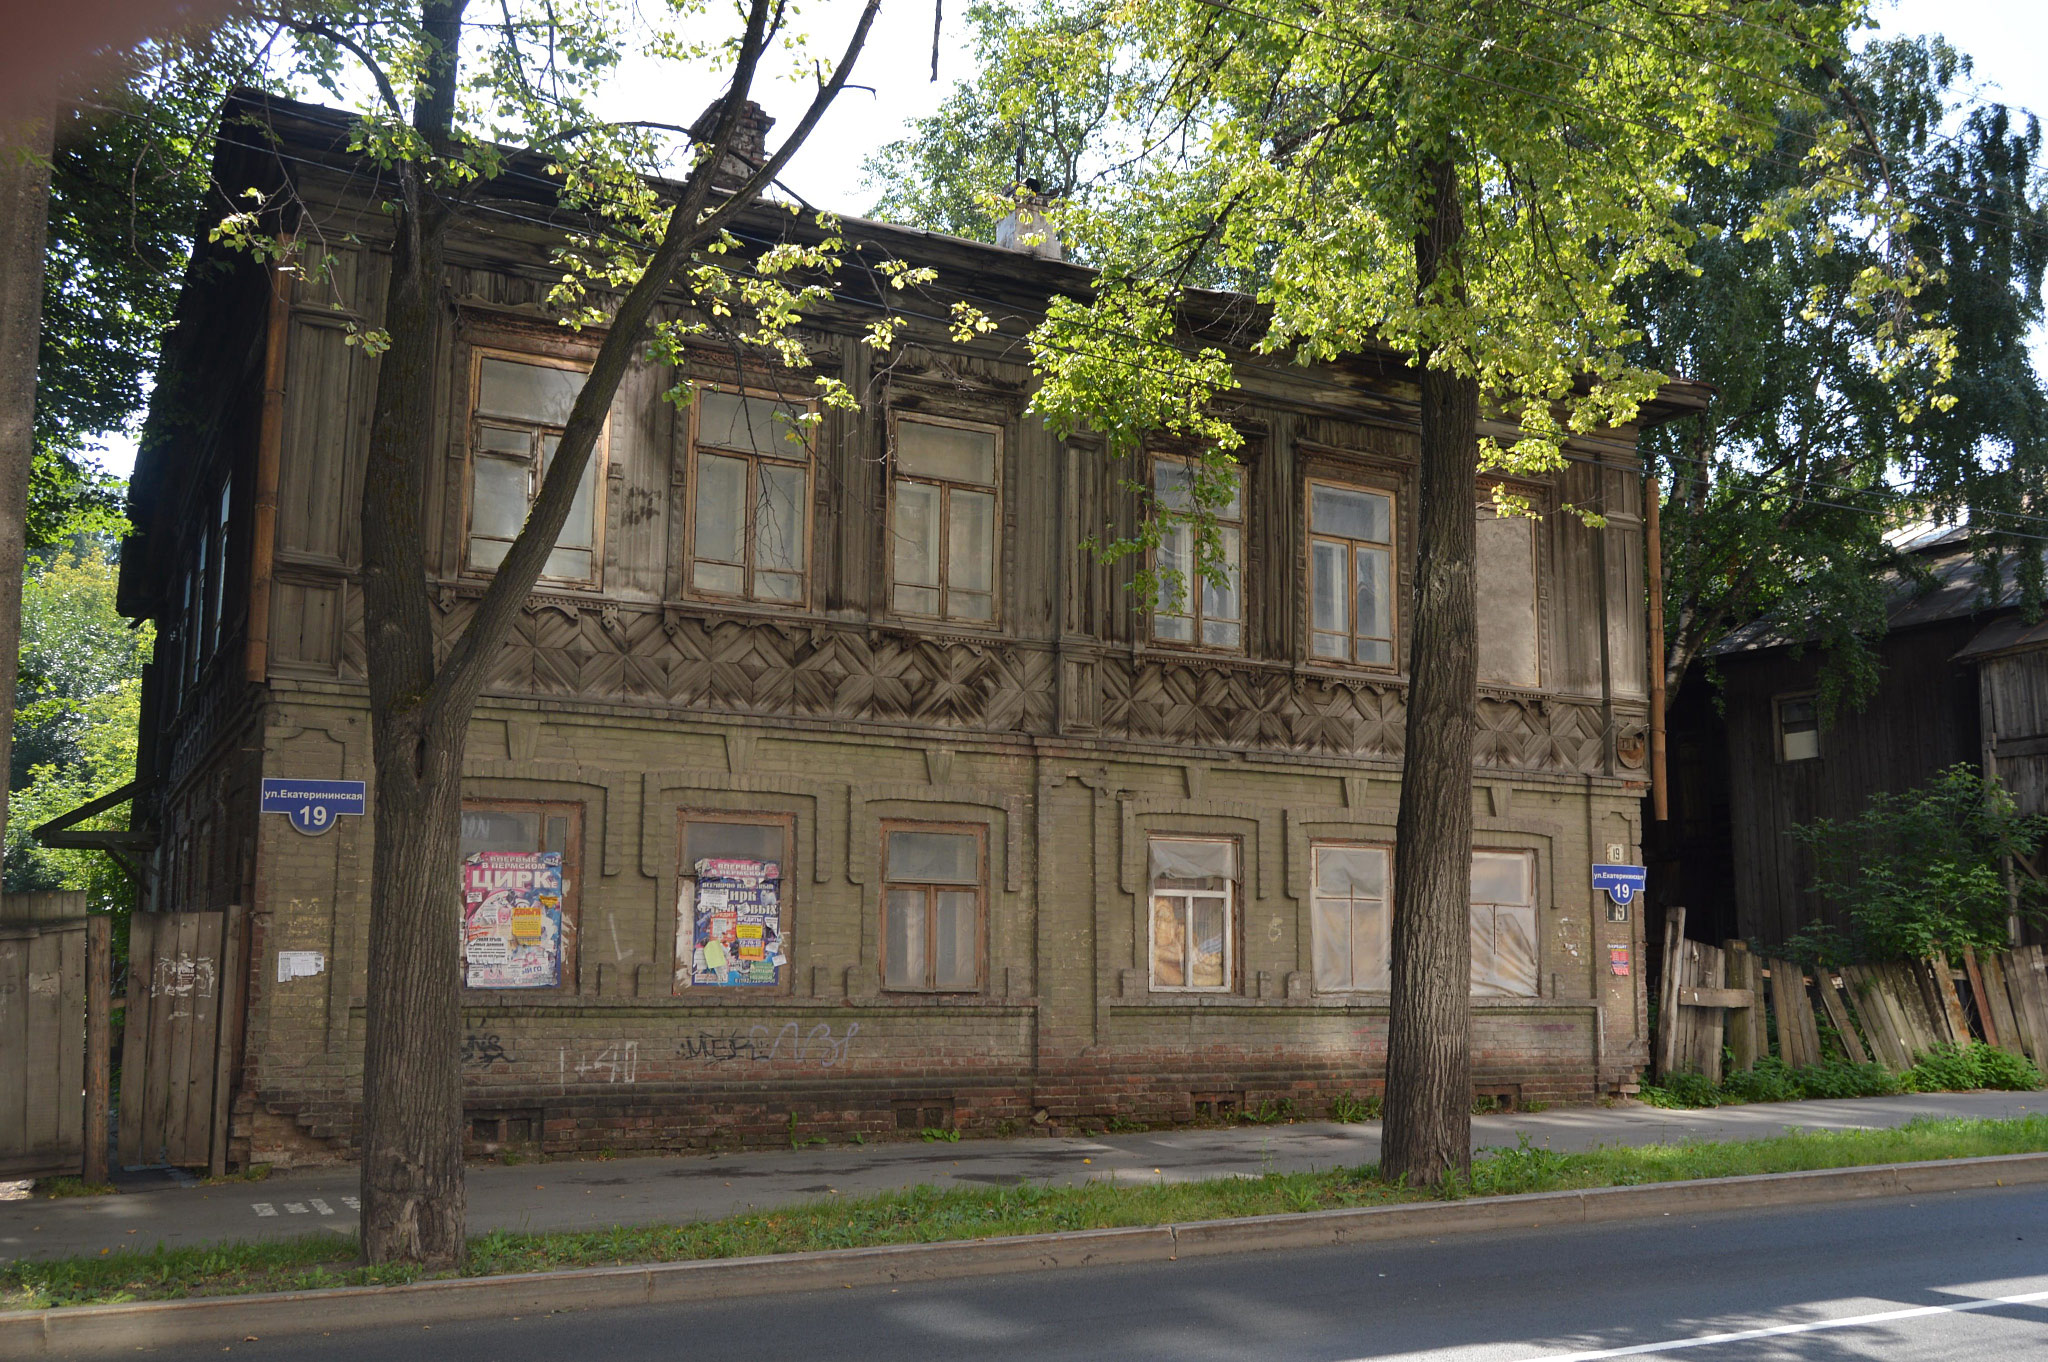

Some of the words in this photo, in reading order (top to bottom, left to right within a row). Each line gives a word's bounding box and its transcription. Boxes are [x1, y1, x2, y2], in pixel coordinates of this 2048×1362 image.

[264, 789, 363, 801] ул.Екатерининская
[299, 805, 327, 826] 19
[1613, 847, 1620, 860] 19
[491, 862, 546, 870] ПЕРМСКОМ
[718, 863, 761, 871] ВПЕРВЫЕ
[1614, 883, 1630, 898] 19
